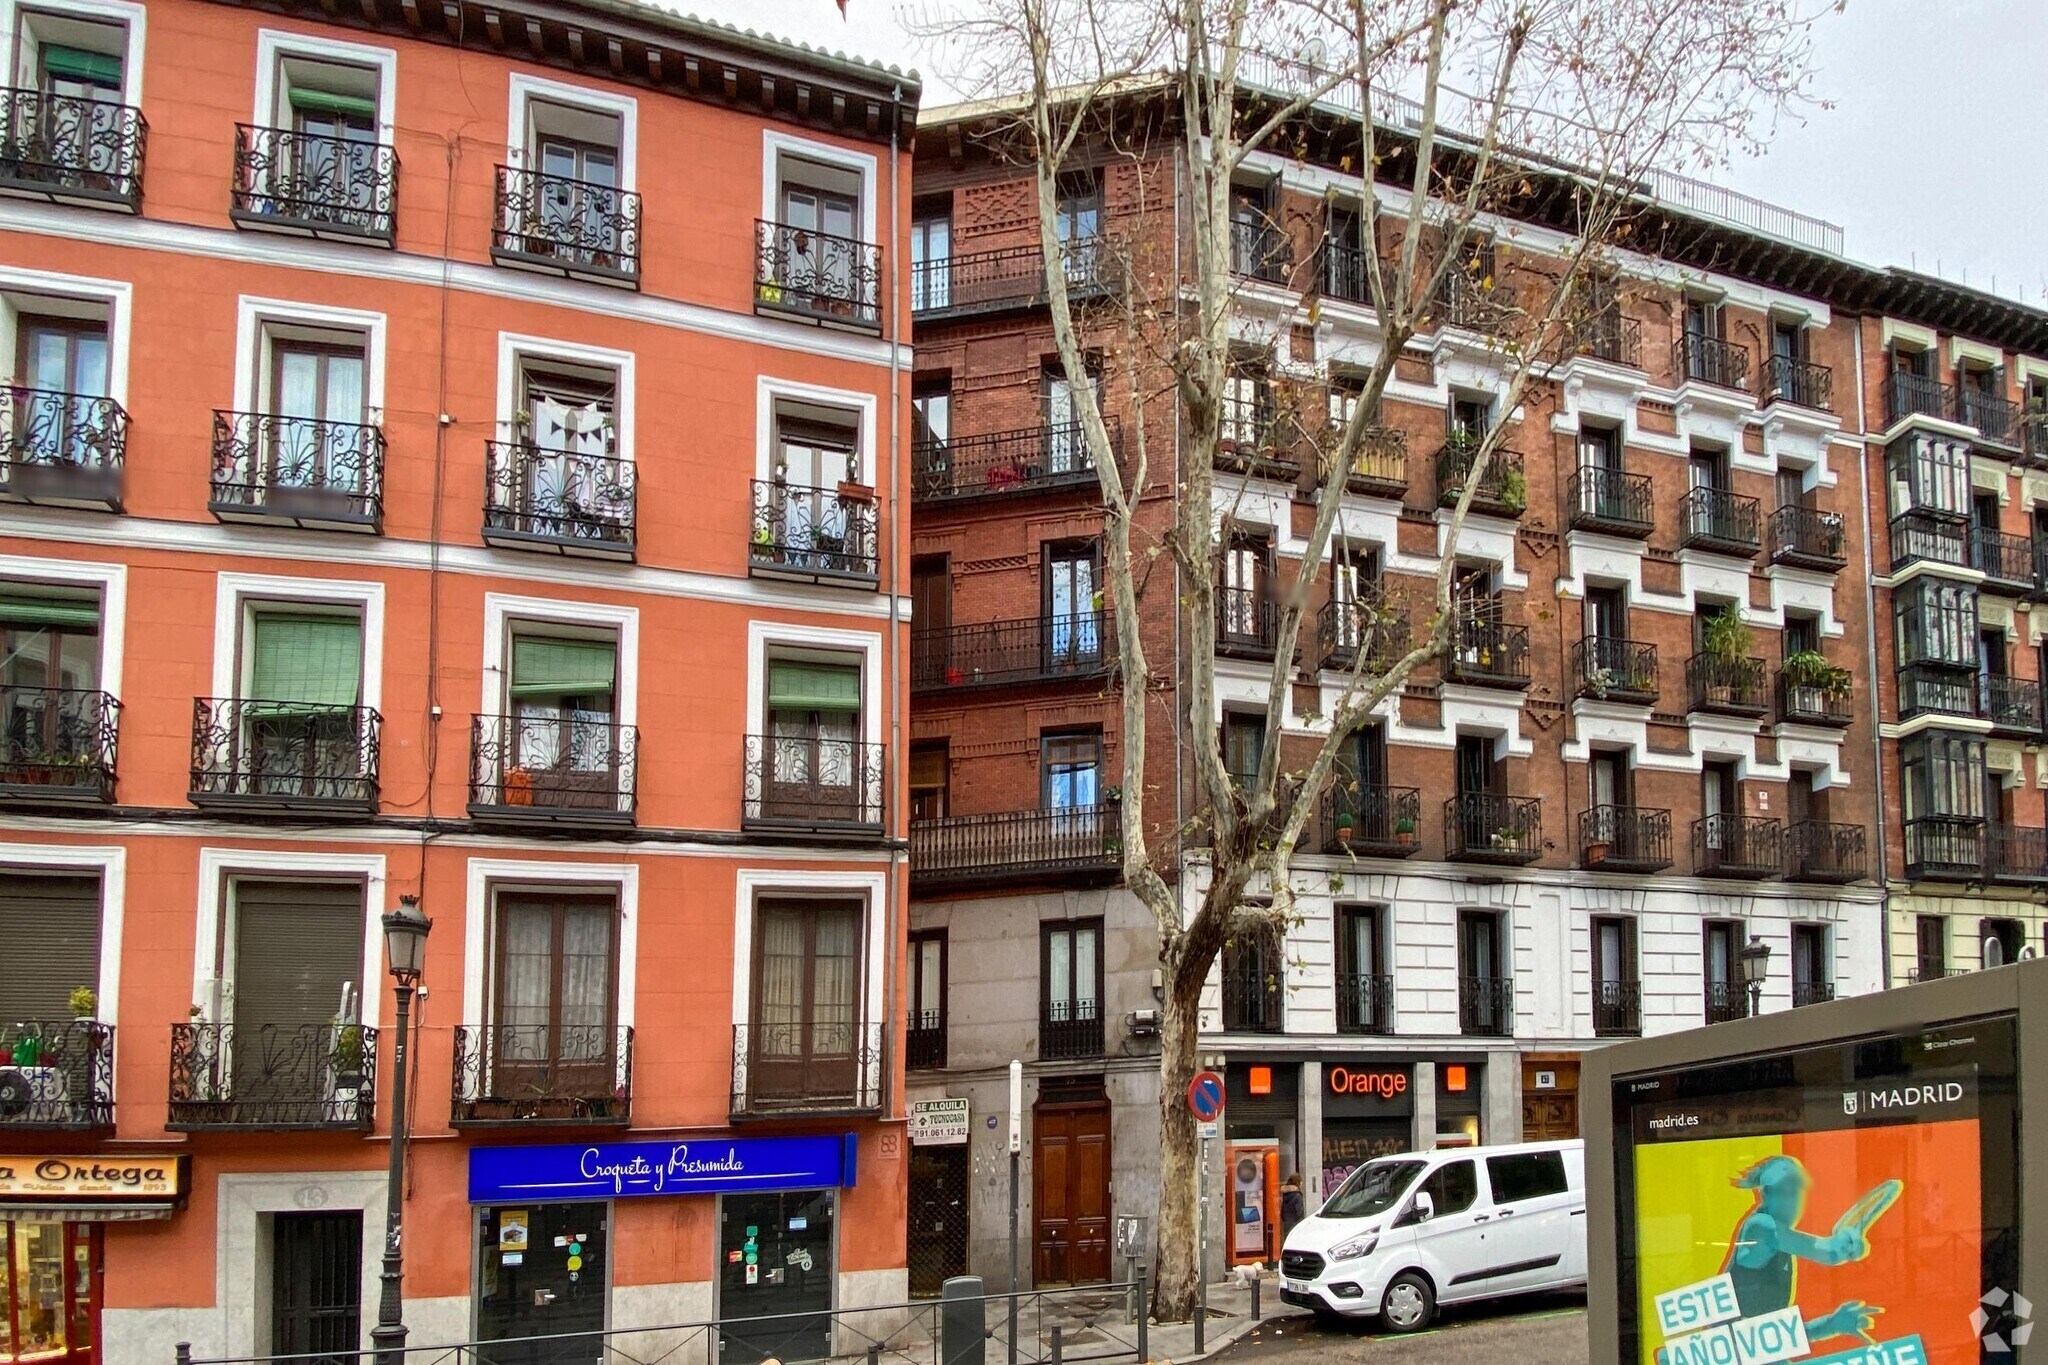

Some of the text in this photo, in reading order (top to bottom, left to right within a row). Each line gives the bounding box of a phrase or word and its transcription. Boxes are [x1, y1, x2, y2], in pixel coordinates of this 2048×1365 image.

[1331, 1067, 1406, 1098] Orange
[1637, 1081, 1660, 1090] MADRID
[1870, 1082, 1963, 1109] MADRID
[916, 1101, 965, 1112] SE ALQUILA
[1649, 1113, 1699, 1129] madrid.es
[35, 1160, 165, 1185] Ortega
[581, 1145, 743, 1193] Croqueta y Presumida
[1660, 1281, 1734, 1329] ESTE
[1673, 1333, 1733, 1365] AÑO
[1736, 1314, 1798, 1358] VOY
